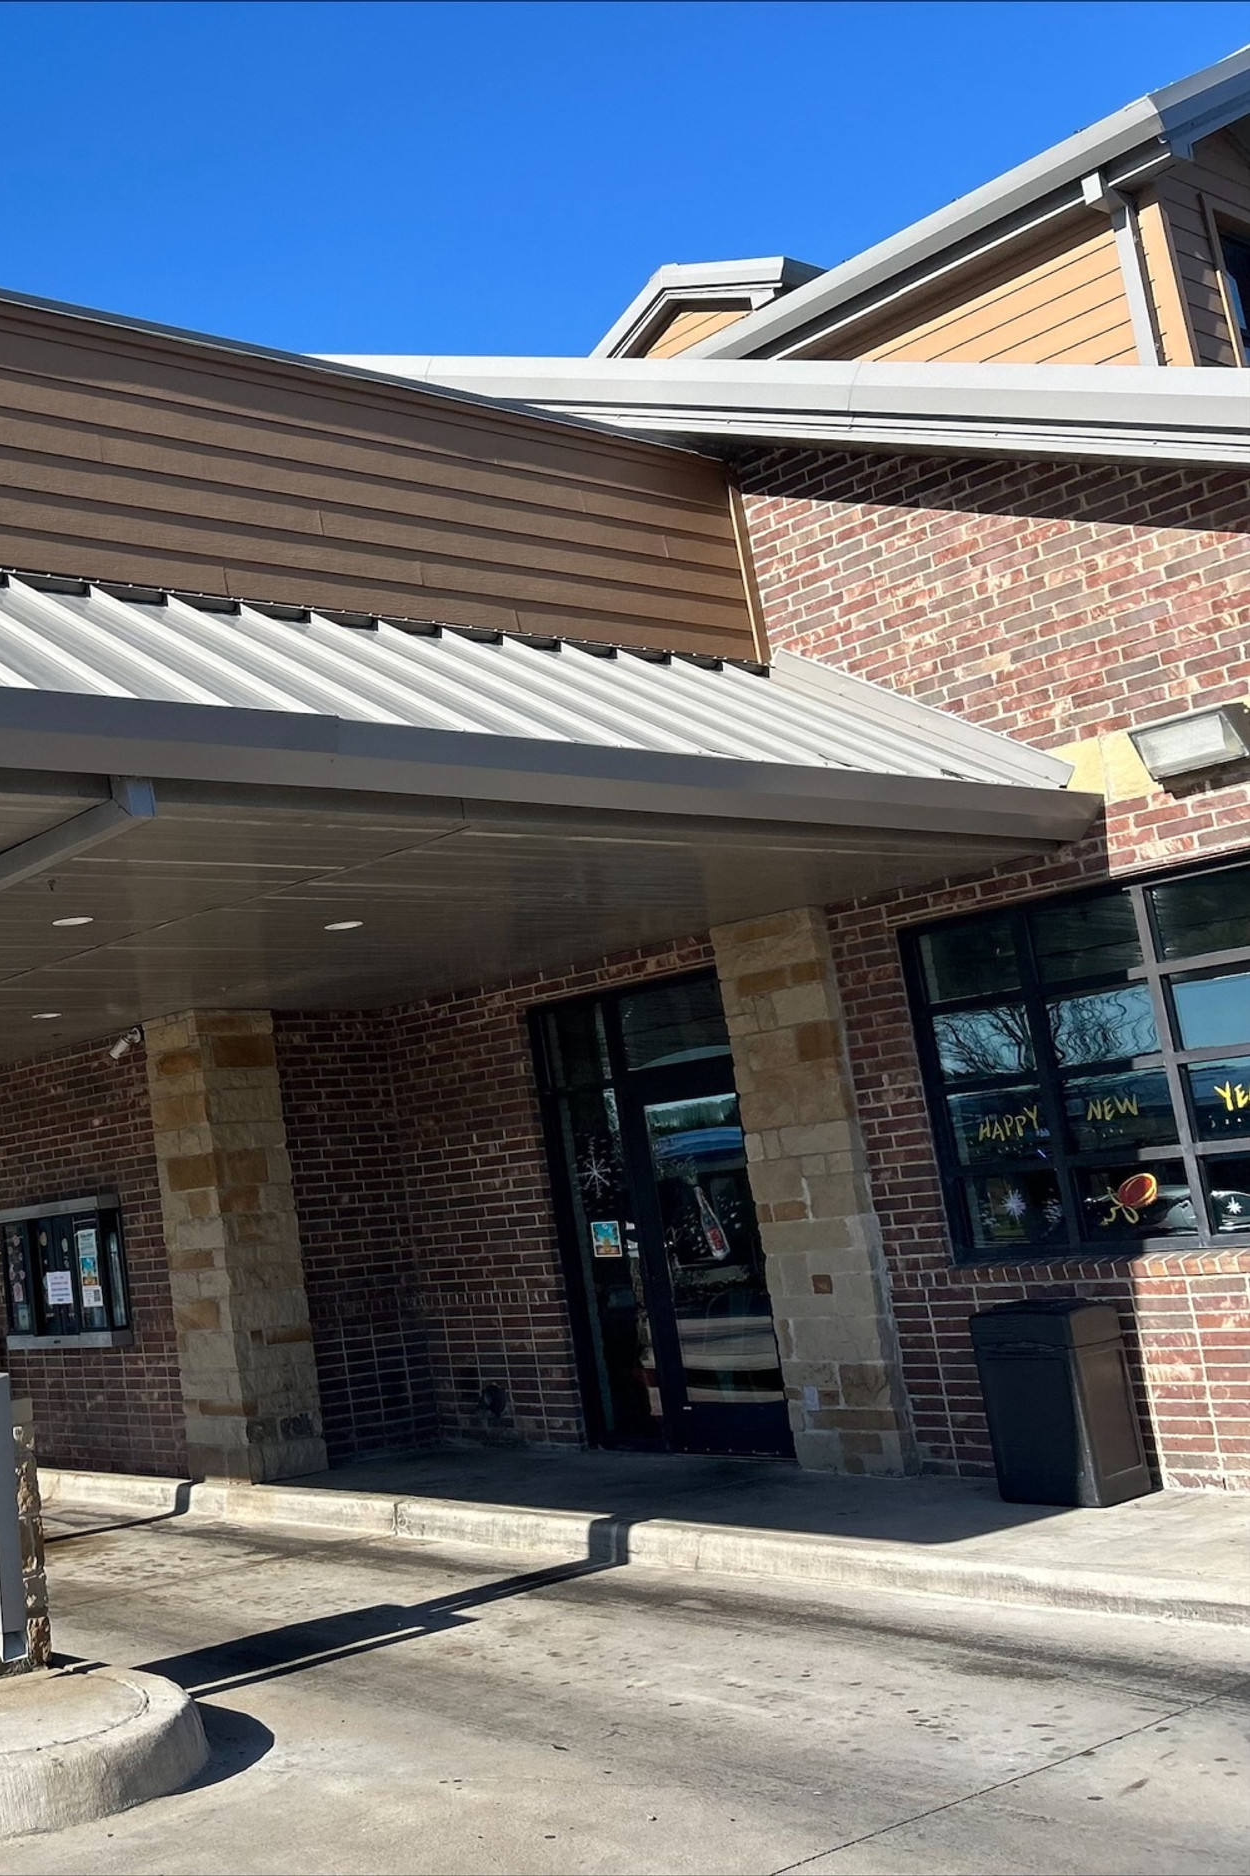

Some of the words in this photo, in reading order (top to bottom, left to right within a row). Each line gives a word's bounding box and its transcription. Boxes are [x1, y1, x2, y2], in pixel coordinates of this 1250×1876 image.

[978, 1104, 1039, 1141] HAPPY
[1087, 1093, 1139, 1121] NEW
[1213, 1080, 1250, 1111] YE
